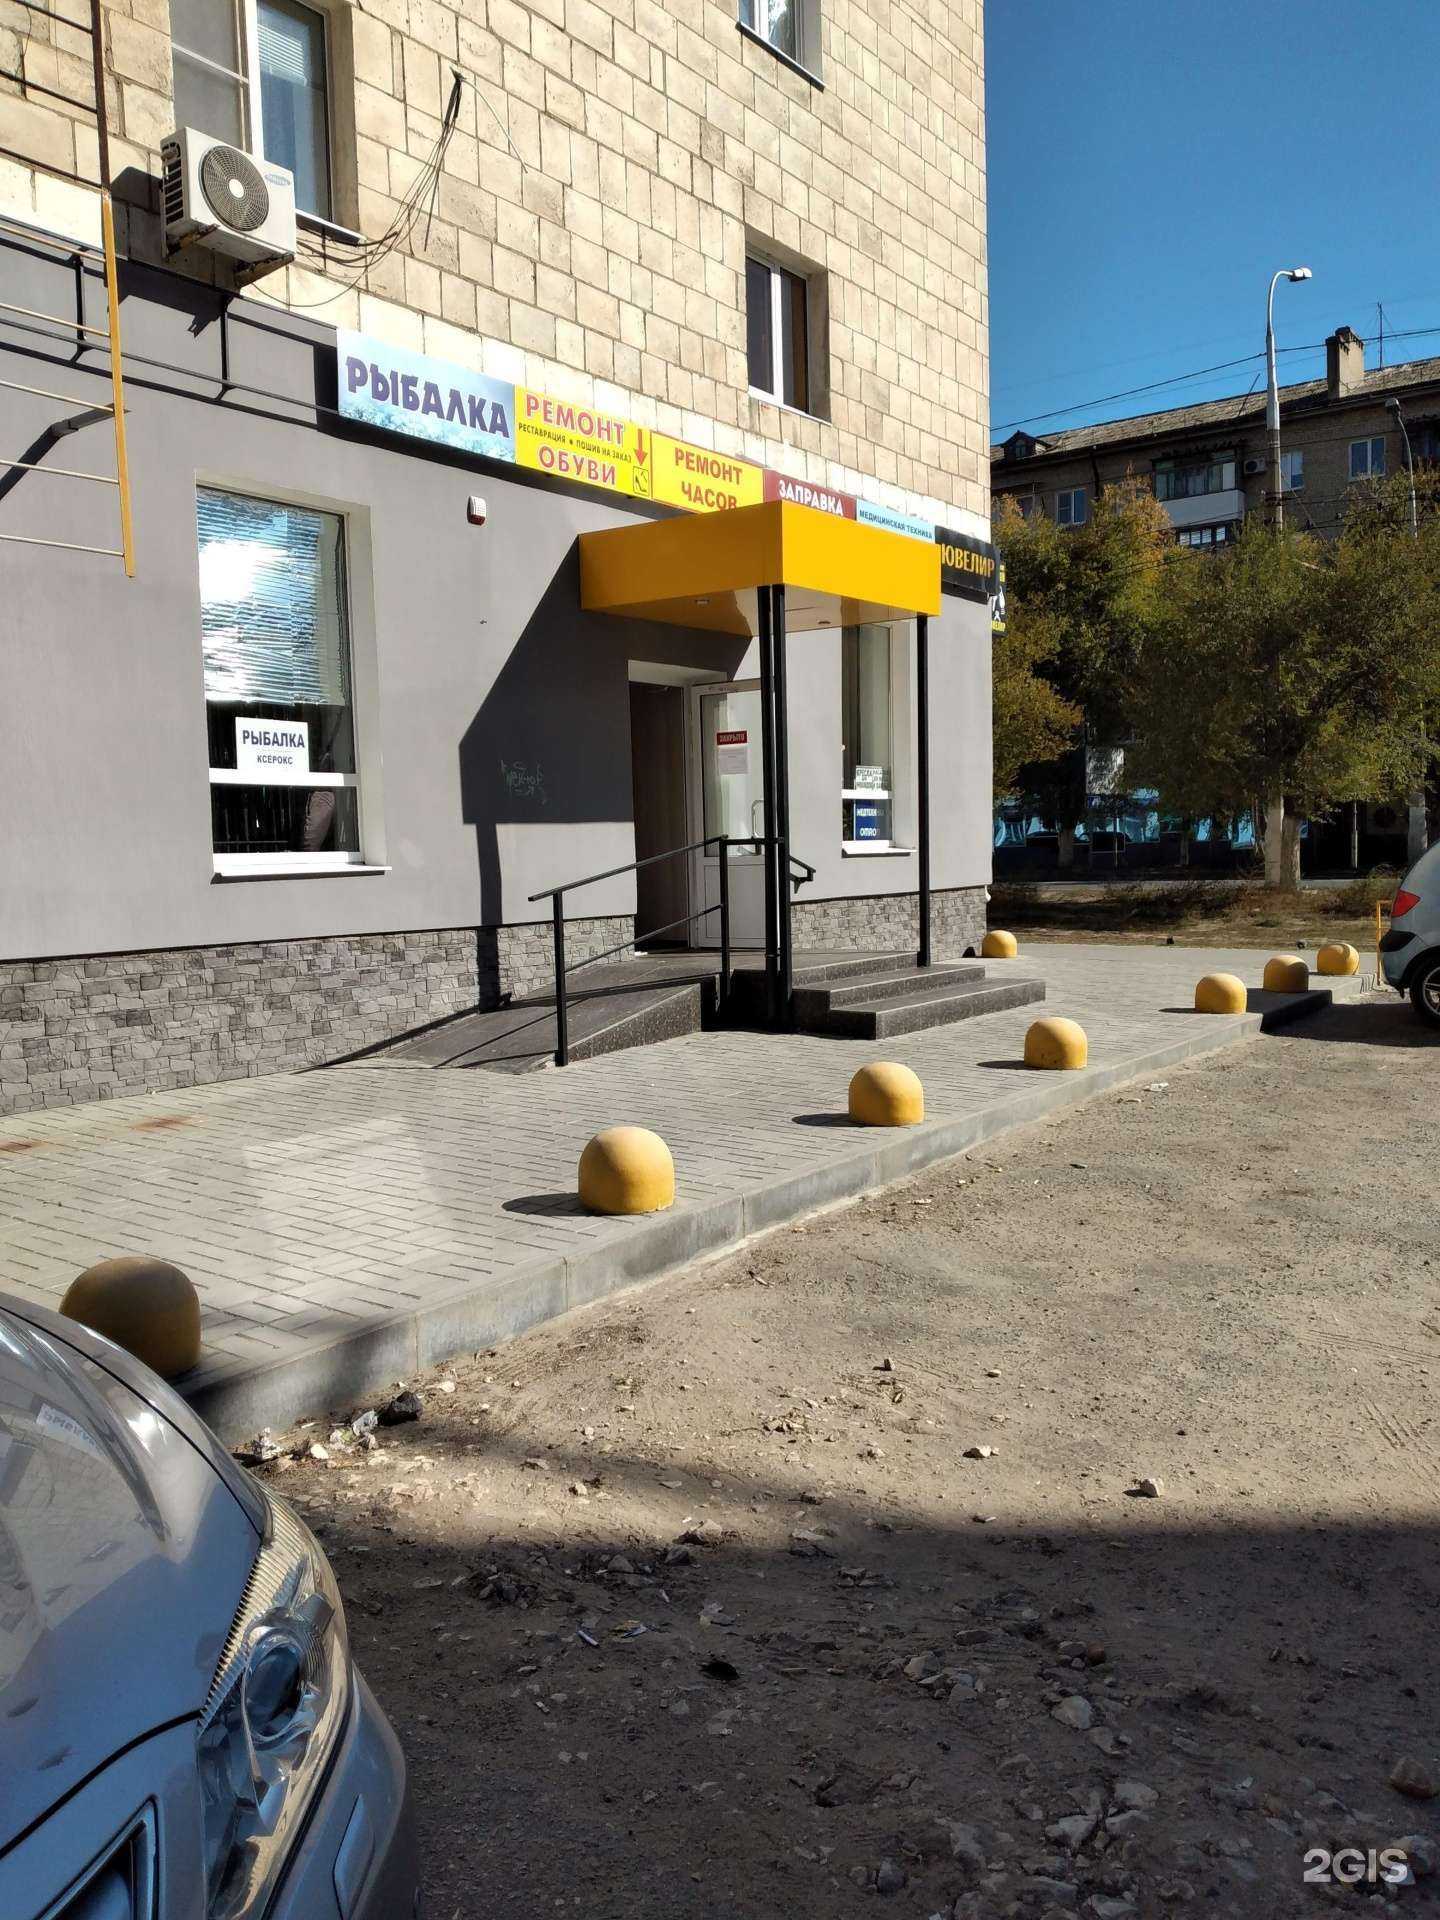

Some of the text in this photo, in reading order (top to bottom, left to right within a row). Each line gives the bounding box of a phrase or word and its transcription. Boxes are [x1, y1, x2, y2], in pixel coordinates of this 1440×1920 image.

[345, 356, 509, 438] РЫБАЛКА
[526, 393, 624, 445] РЕМОНТ
[518, 422, 632, 463] РЕСТАВРАЦИЯ ПОШИВ НА ЗАКАЗ
[539, 446, 615, 486] ОБУВИ
[675, 447, 743, 485] РЕМОНТ
[681, 481, 737, 511] ЧАСОВ
[778, 479, 843, 516] ЗАПРАВКА
[859, 510, 933, 540] МЕДИЦИНСКАЯ ТЕХНИКА
[941, 543, 995, 578] ЮВЕЛИР
[242, 729, 305, 748] РЫБАЛКА
[257, 755, 293, 765] КСЕРОКС
